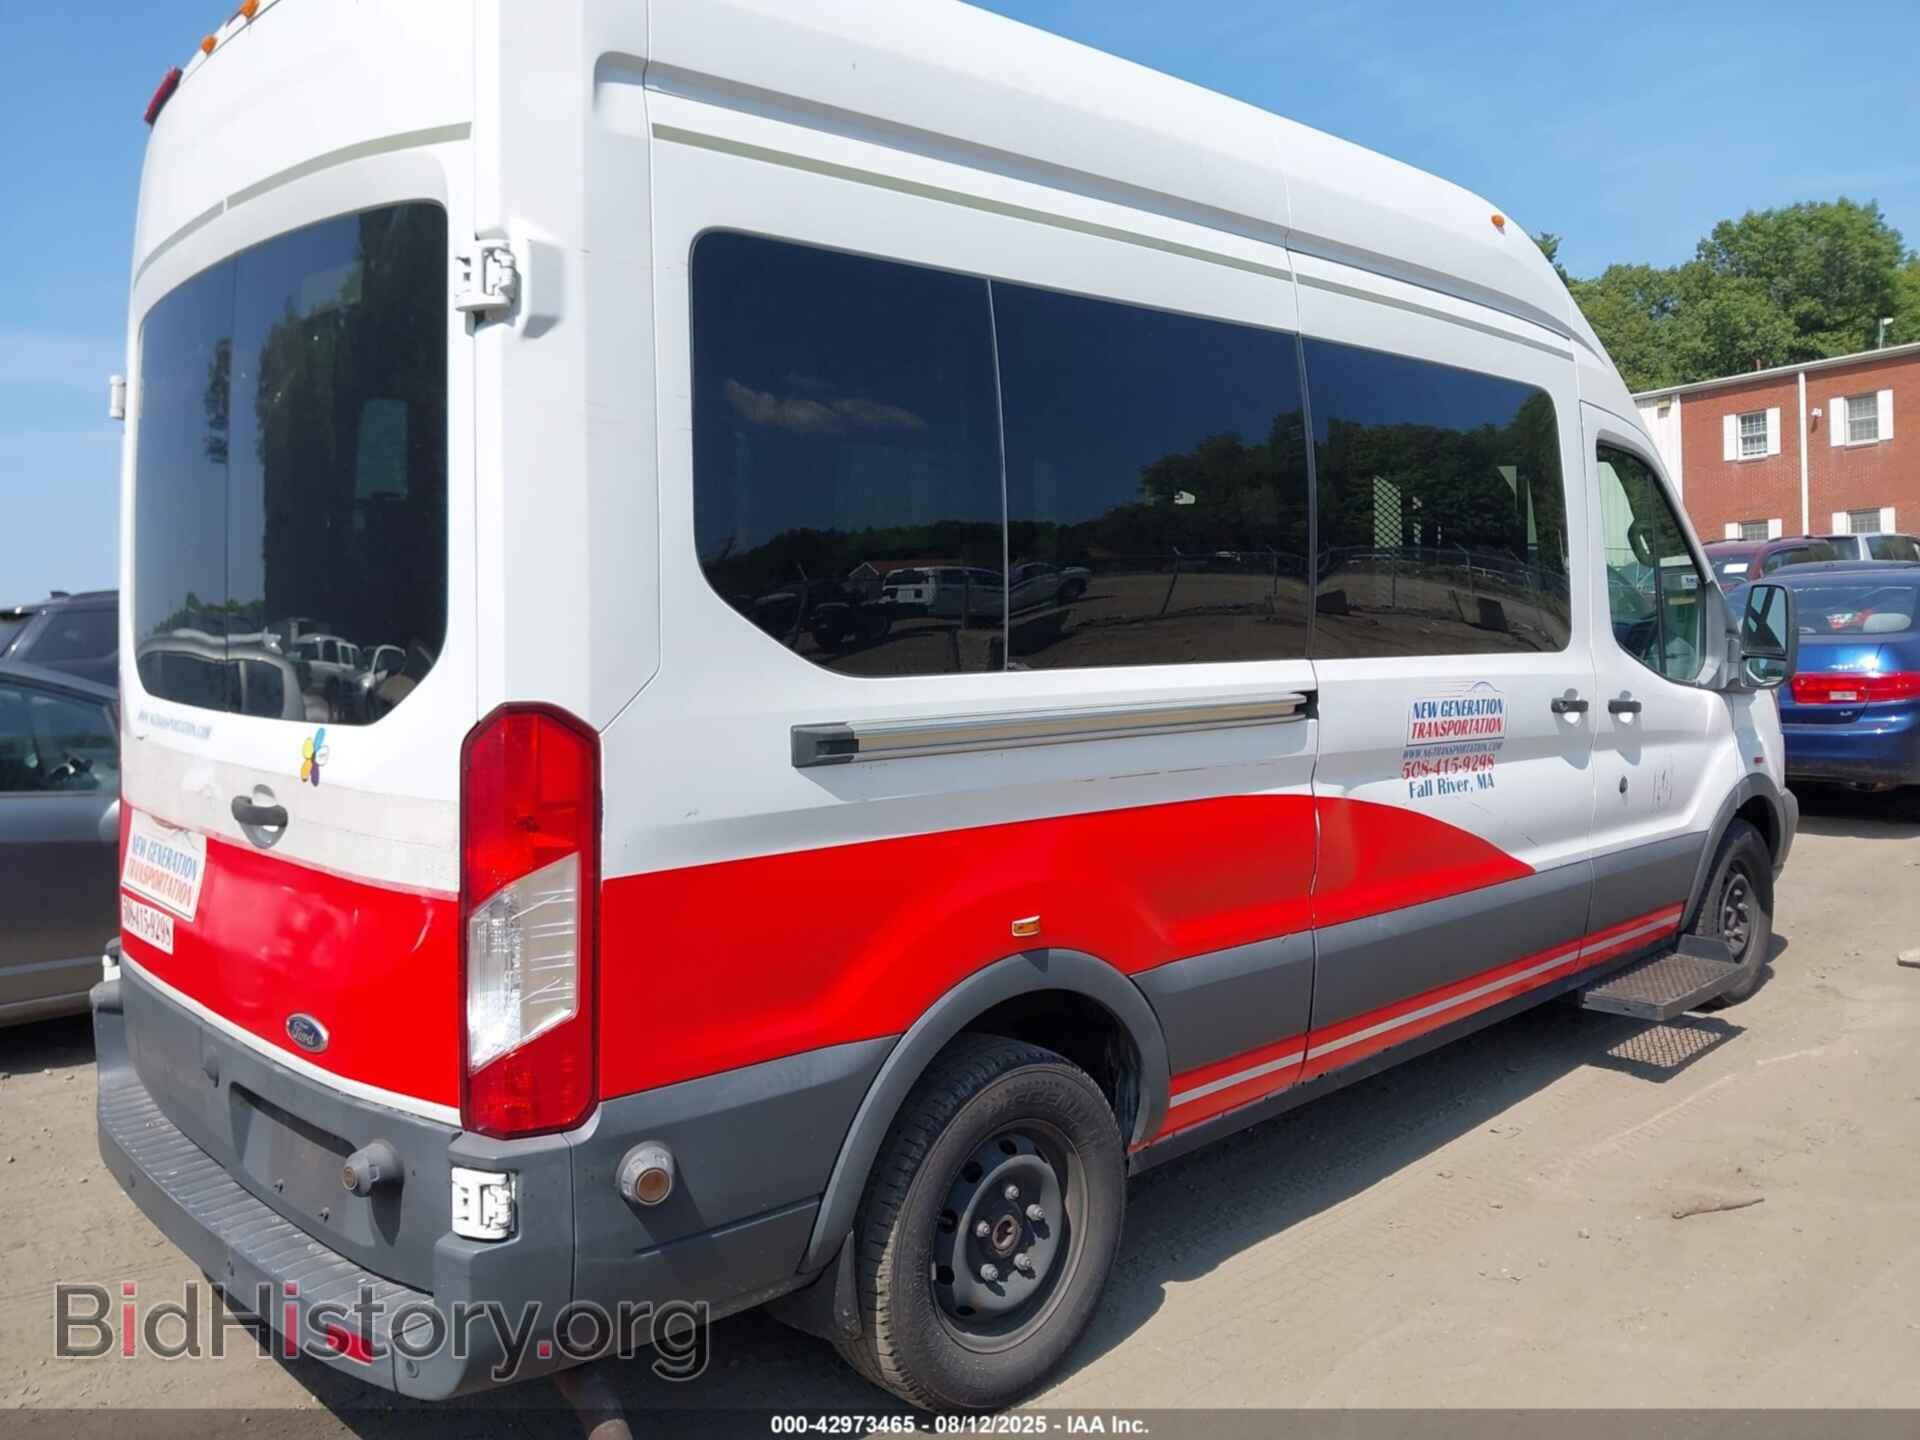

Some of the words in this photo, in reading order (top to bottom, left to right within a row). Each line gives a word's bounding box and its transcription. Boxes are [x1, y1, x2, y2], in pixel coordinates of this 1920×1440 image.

[1413, 702, 1439, 719] NEW
[1440, 698, 1504, 717] GENERATION
[1411, 717, 1503, 739] TRANSPORTATION
[1408, 778, 1433, 799] Fall
[1437, 776, 1474, 796] River,
[1476, 772, 1495, 790] MA
[146, 840, 197, 881] GENERATION
